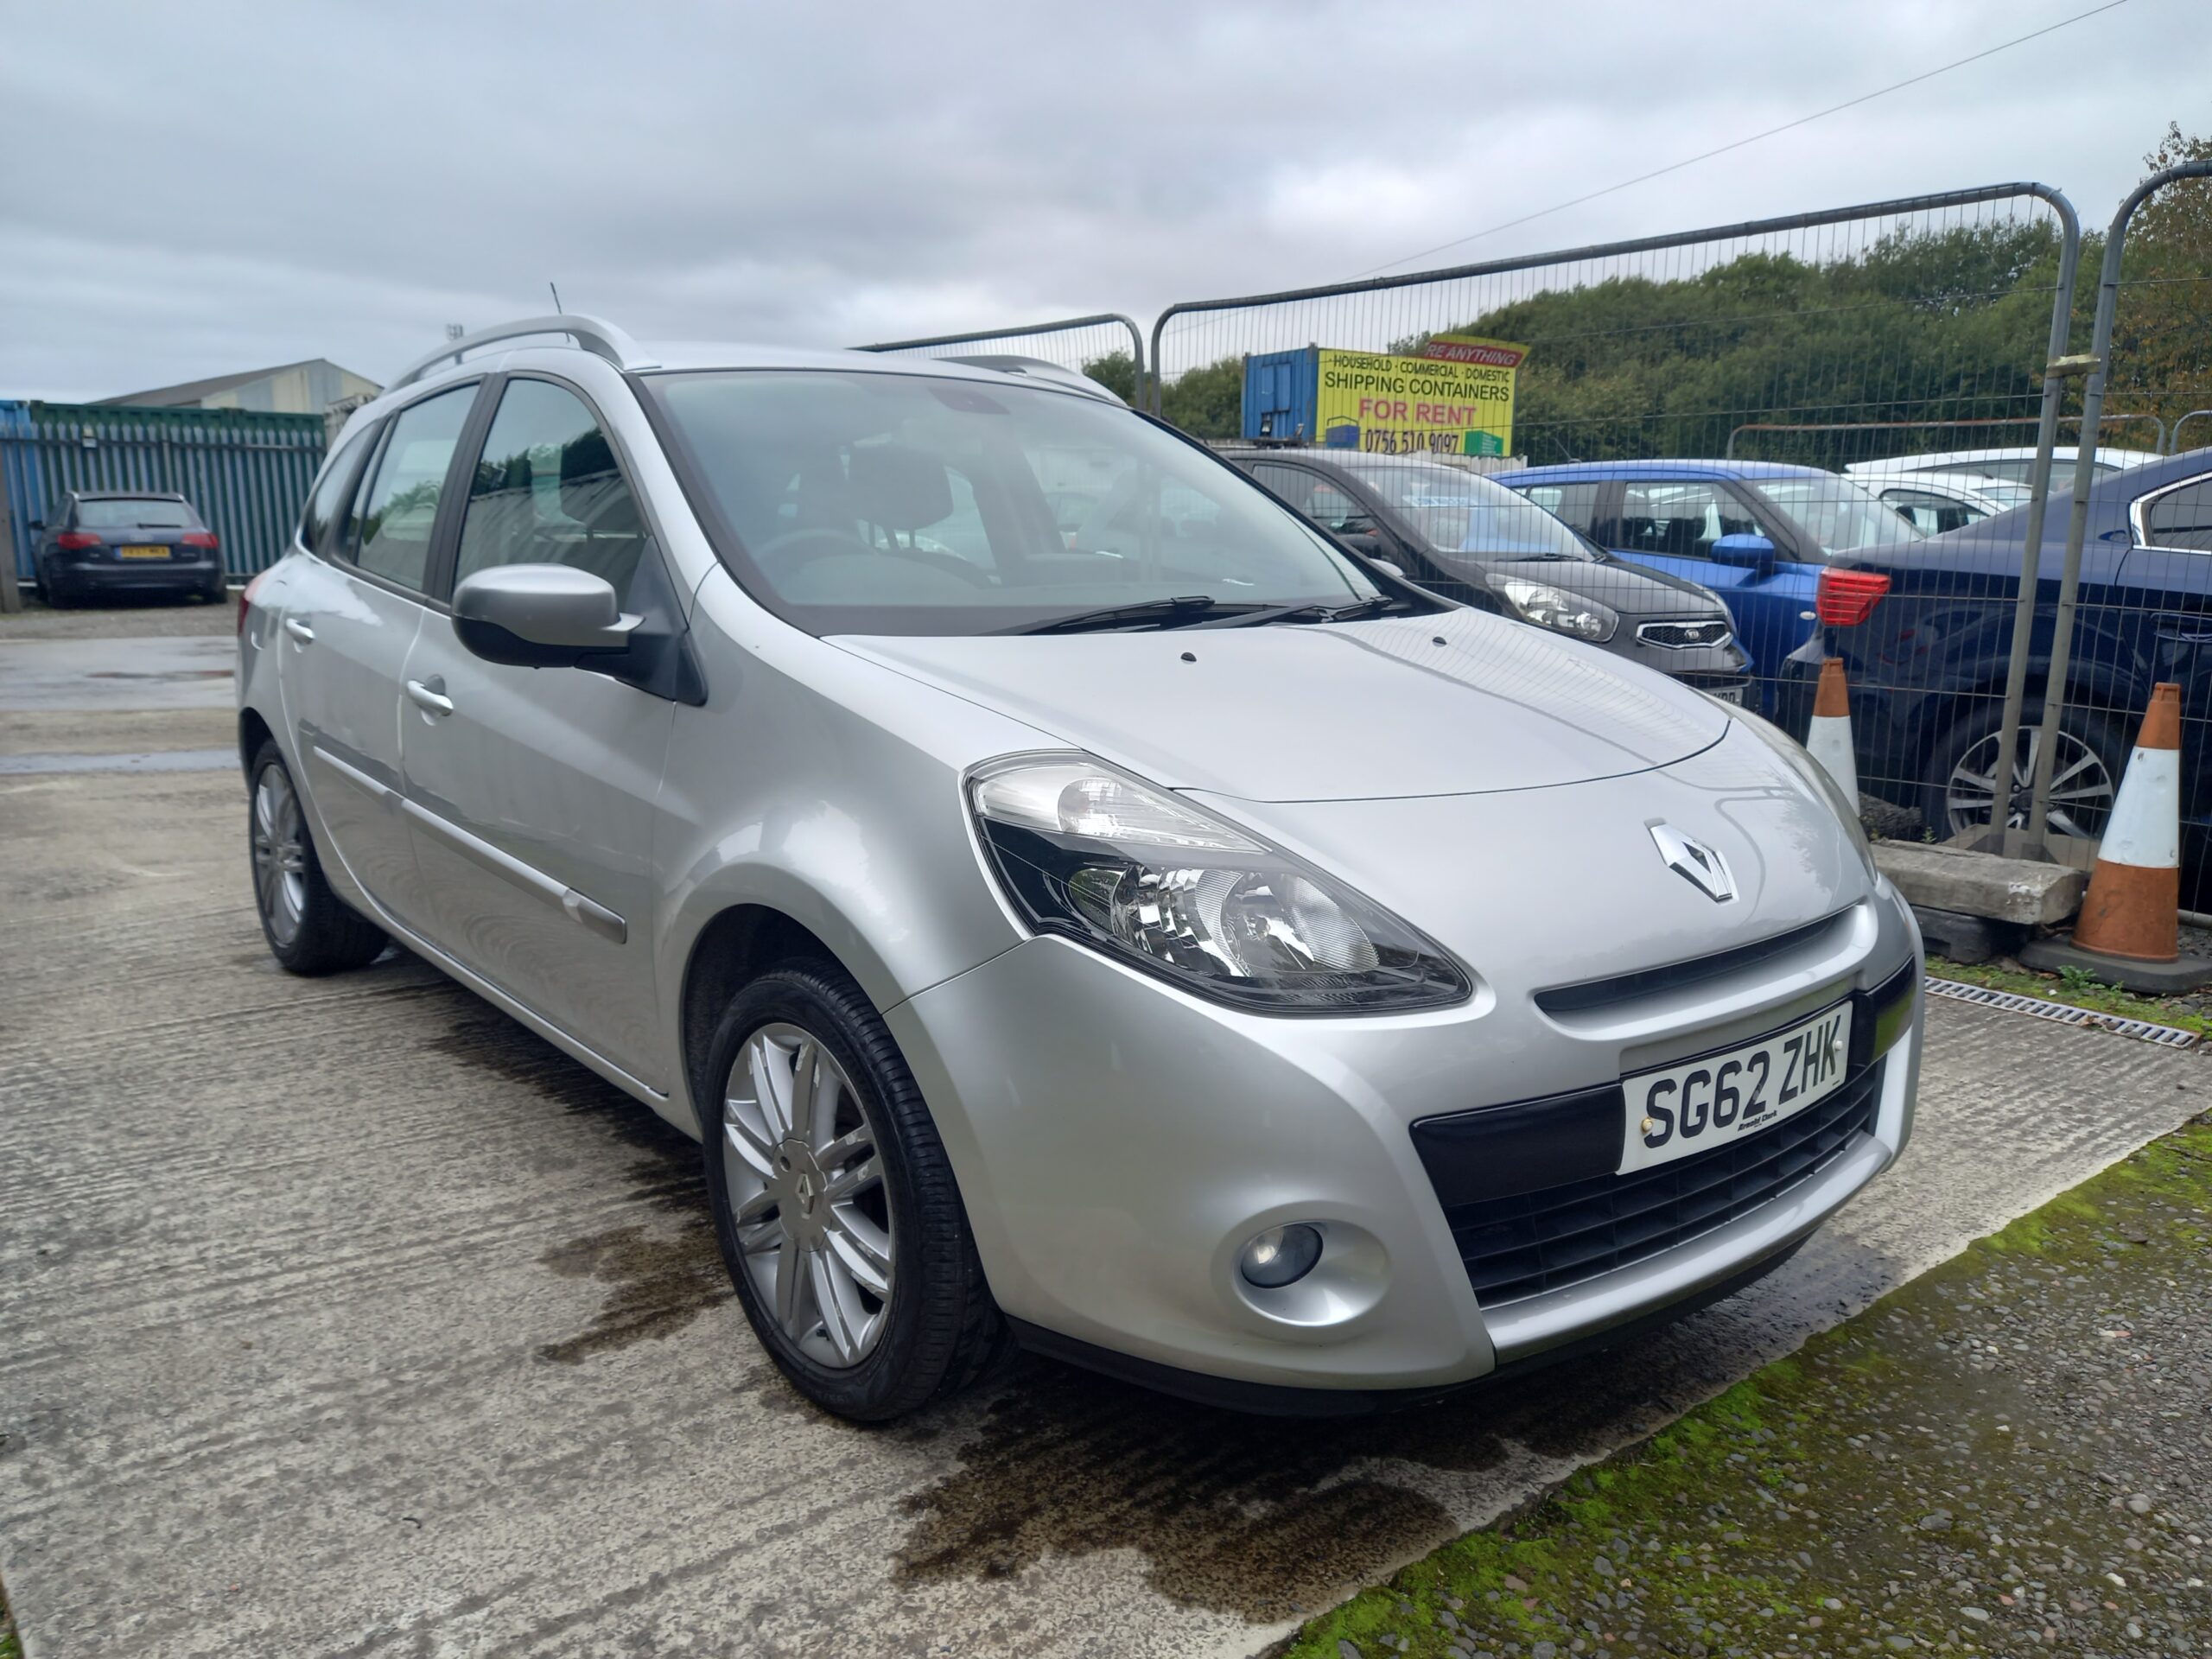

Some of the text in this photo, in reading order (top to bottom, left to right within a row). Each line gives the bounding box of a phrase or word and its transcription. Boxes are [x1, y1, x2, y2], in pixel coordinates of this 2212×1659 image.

[1333, 355, 1510, 383] HOUSEHOLD COMMERCIAL DOMESTIC
[1446, 346, 1517, 365] ANYTHING
[1325, 372, 1510, 402] SHIPPING CONTAINERS
[1359, 398, 1477, 426] FOR RENT
[1365, 429, 1396, 454] 0756
[1402, 432, 1425, 454] 510
[1428, 434, 1459, 454] 9097
[1643, 1014, 1841, 1149] SG62 ZHK
